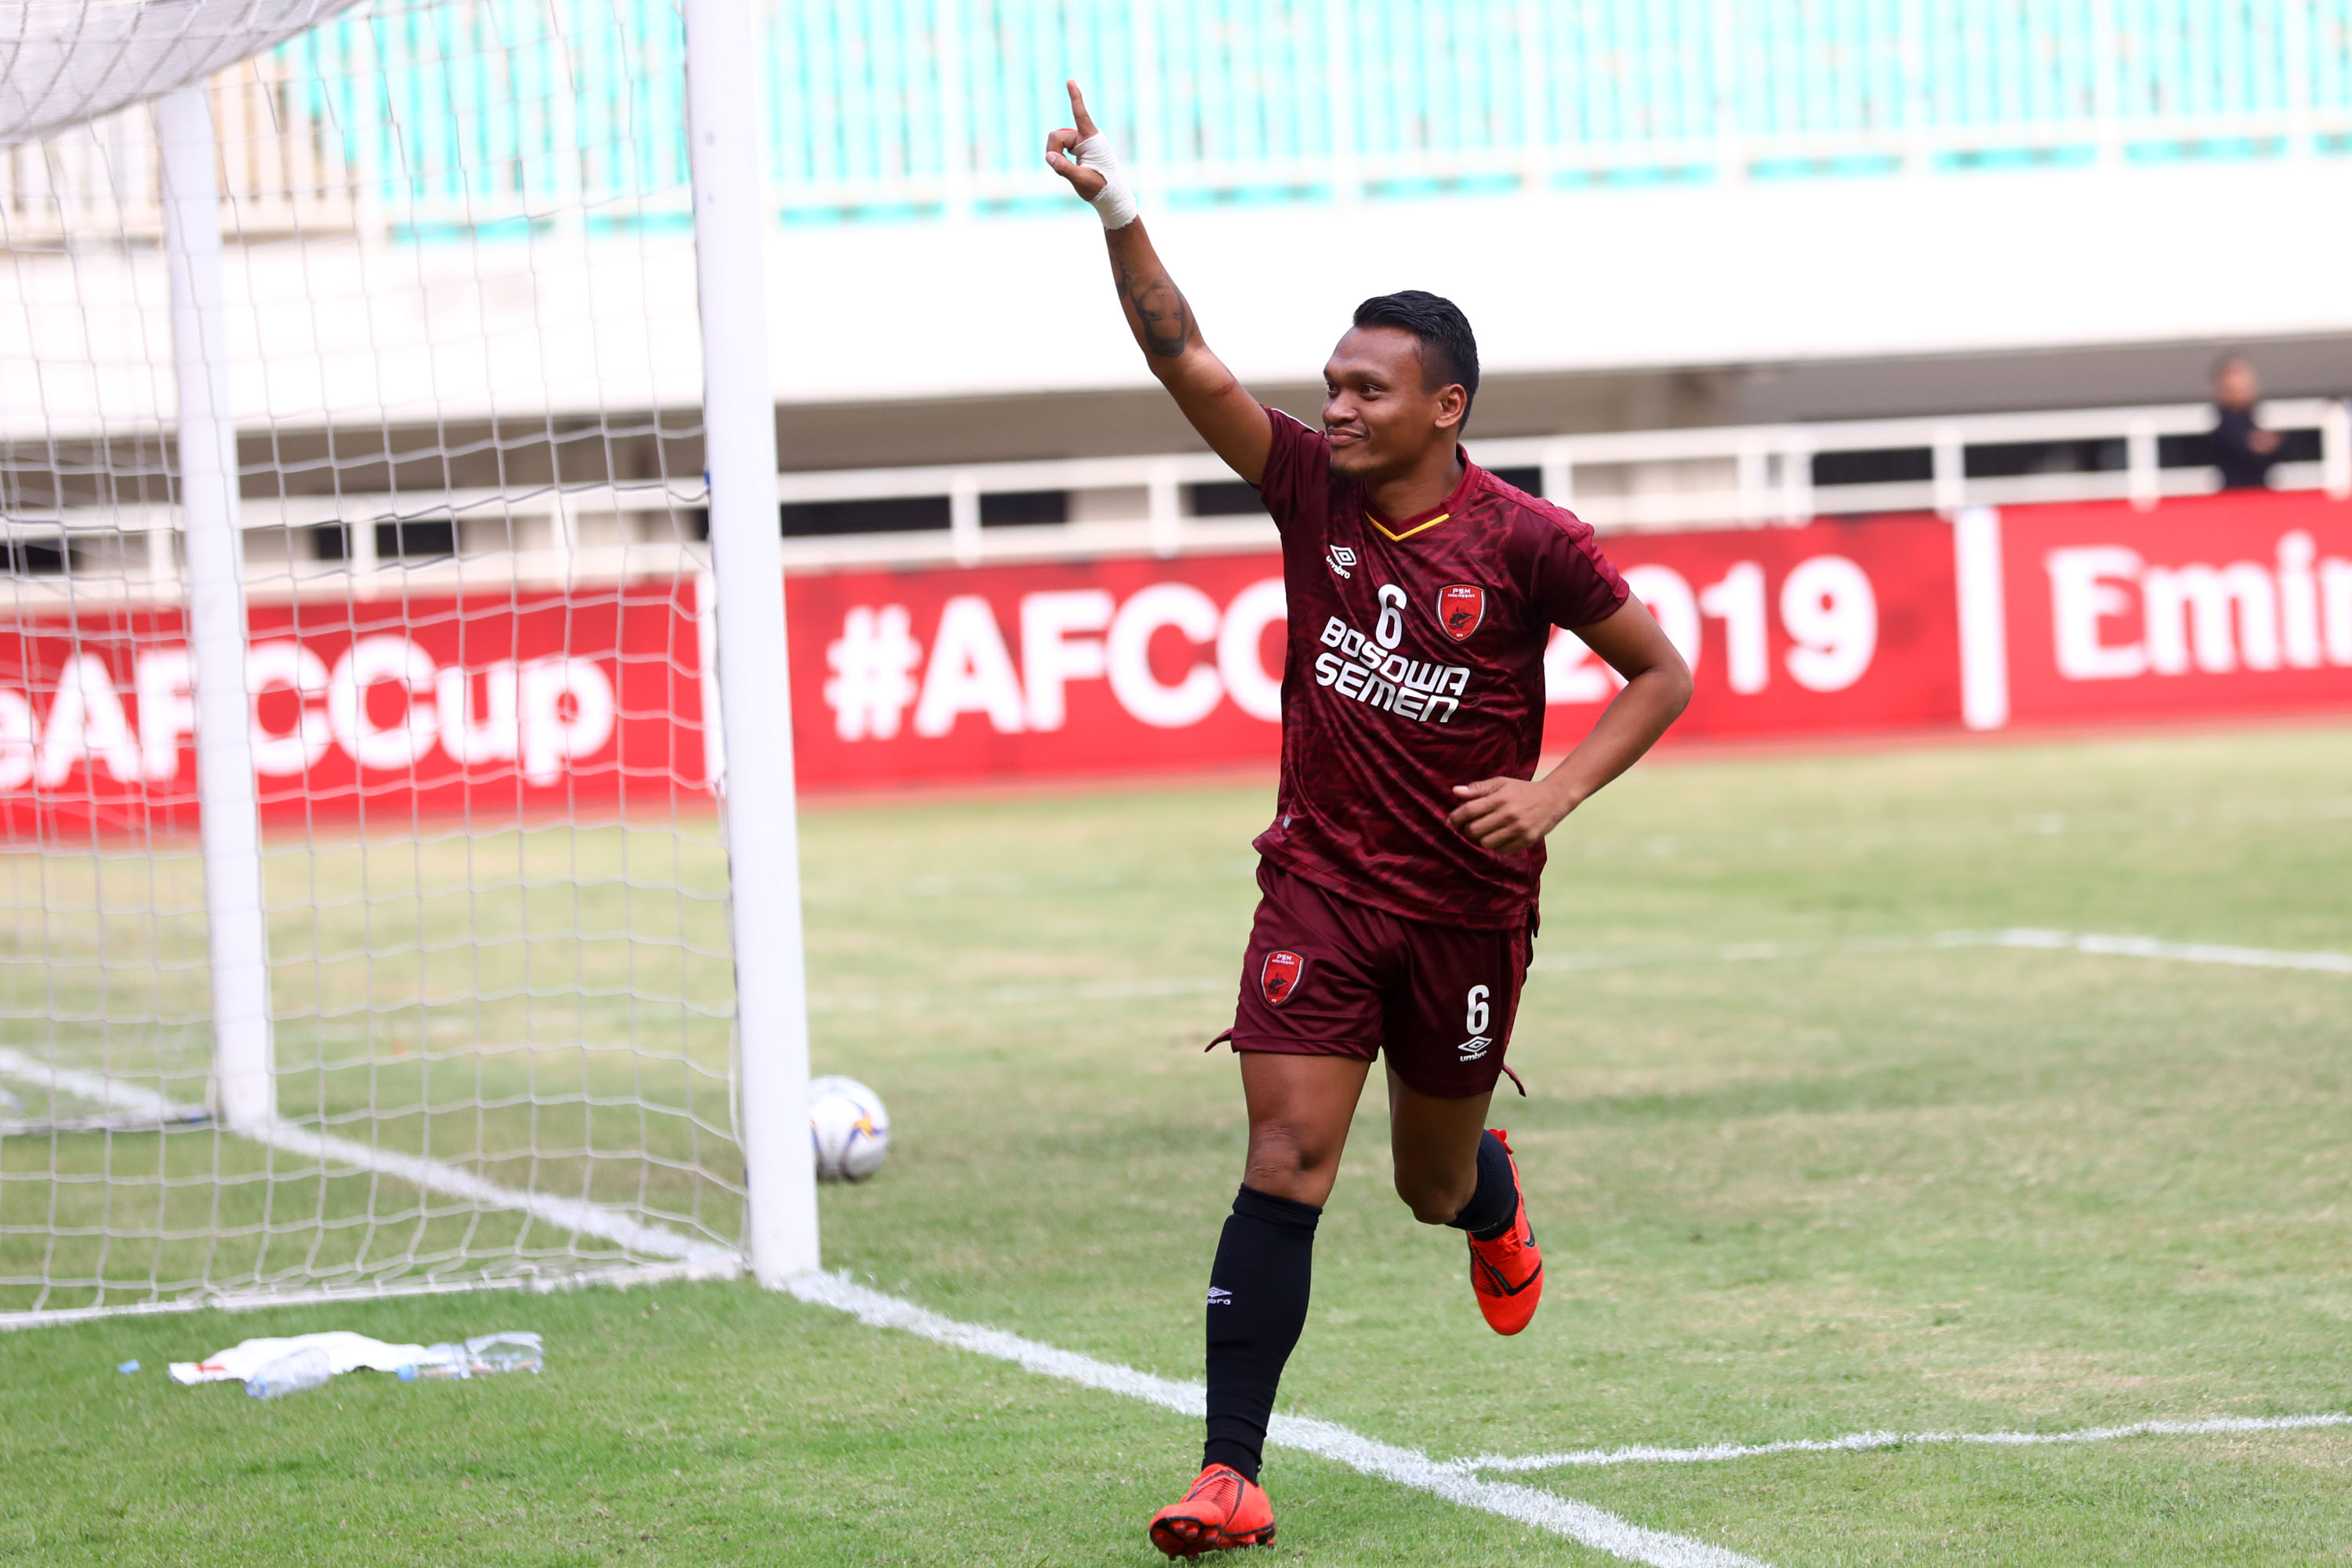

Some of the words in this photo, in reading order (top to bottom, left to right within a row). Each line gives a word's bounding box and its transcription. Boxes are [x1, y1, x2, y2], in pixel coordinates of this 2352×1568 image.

[1326, 555, 1351, 579] umbro
[1375, 584, 1407, 649] 6
[1315, 652, 1460, 723] SEMEN
[1319, 615, 1471, 696] BOSOWA
[1466, 985, 1490, 1035] 6
